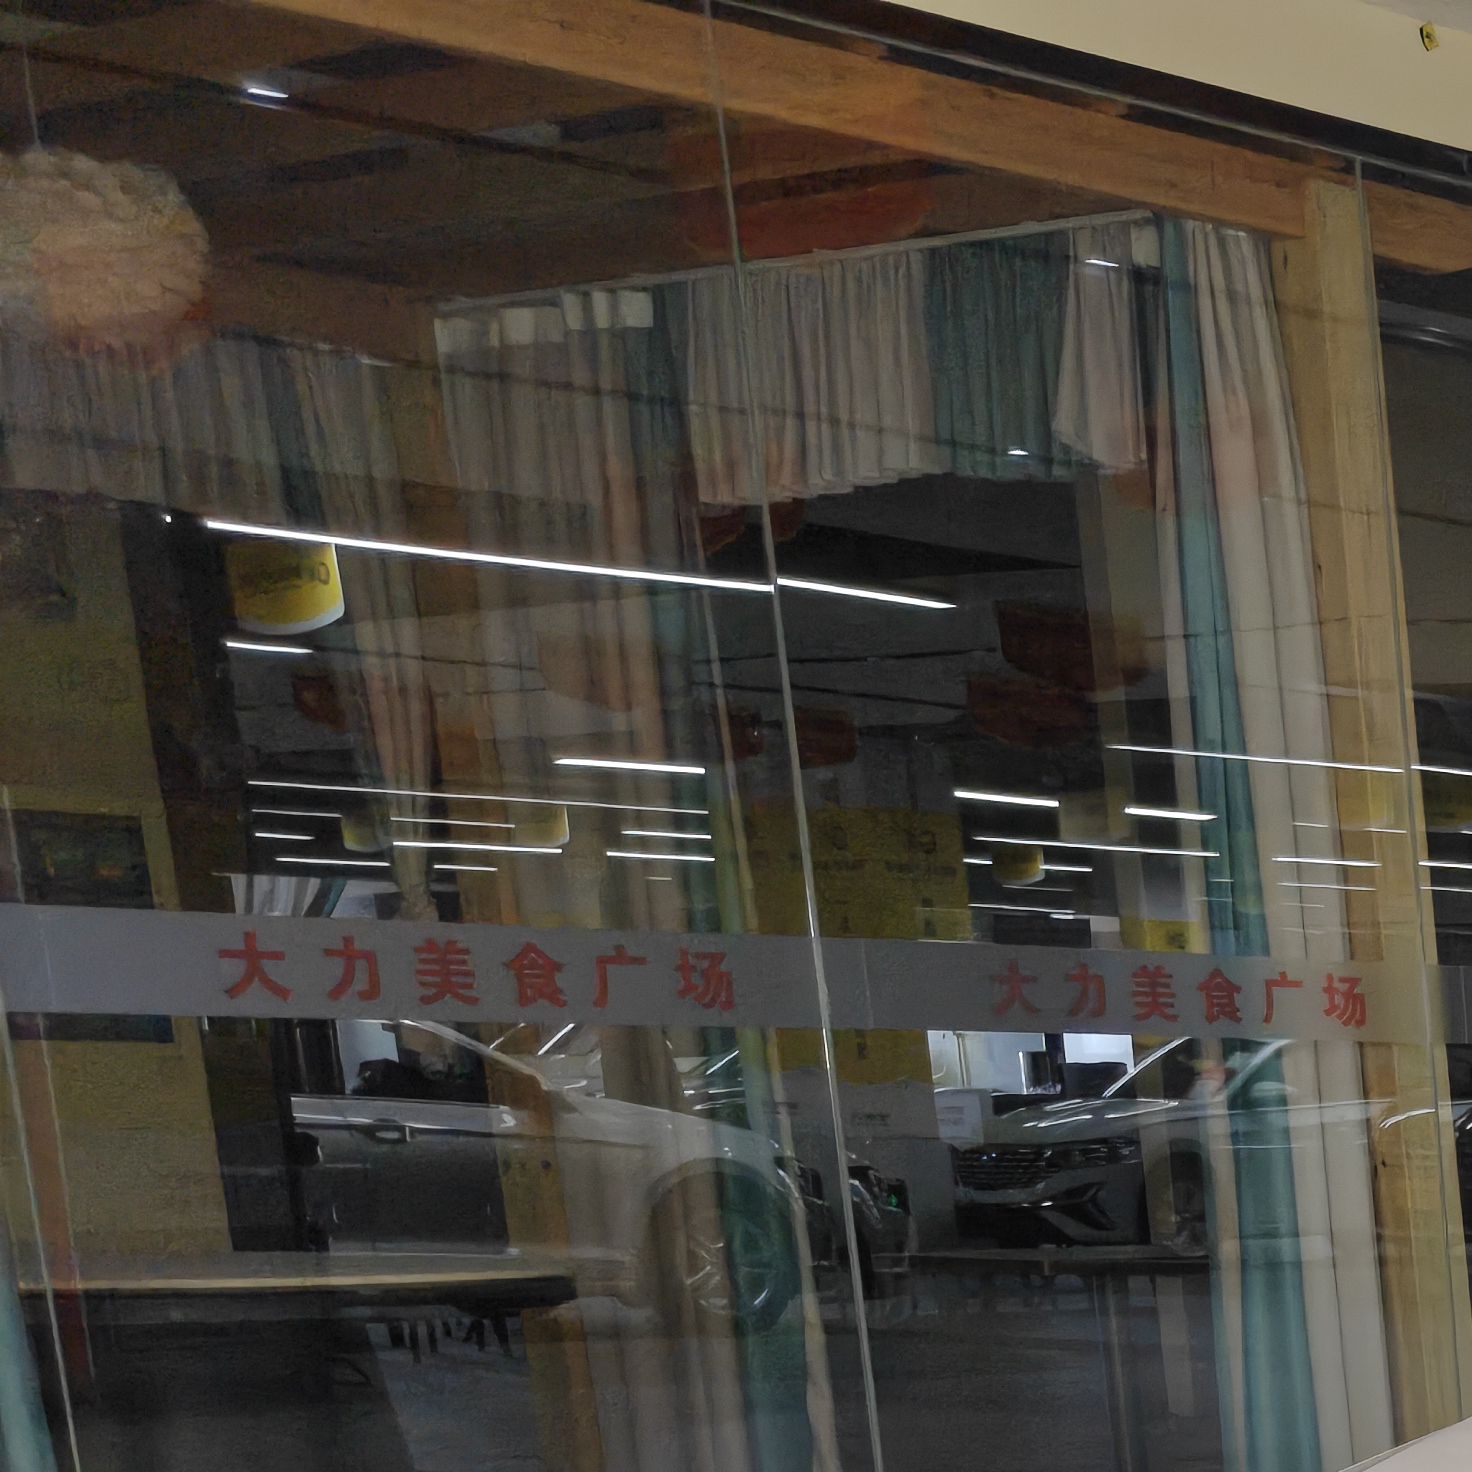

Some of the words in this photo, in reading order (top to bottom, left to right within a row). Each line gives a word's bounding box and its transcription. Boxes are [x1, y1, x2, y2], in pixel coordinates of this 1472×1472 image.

[218, 929, 736, 1011] 大力美食广场
[991, 960, 1367, 1029] 大力美食广场
